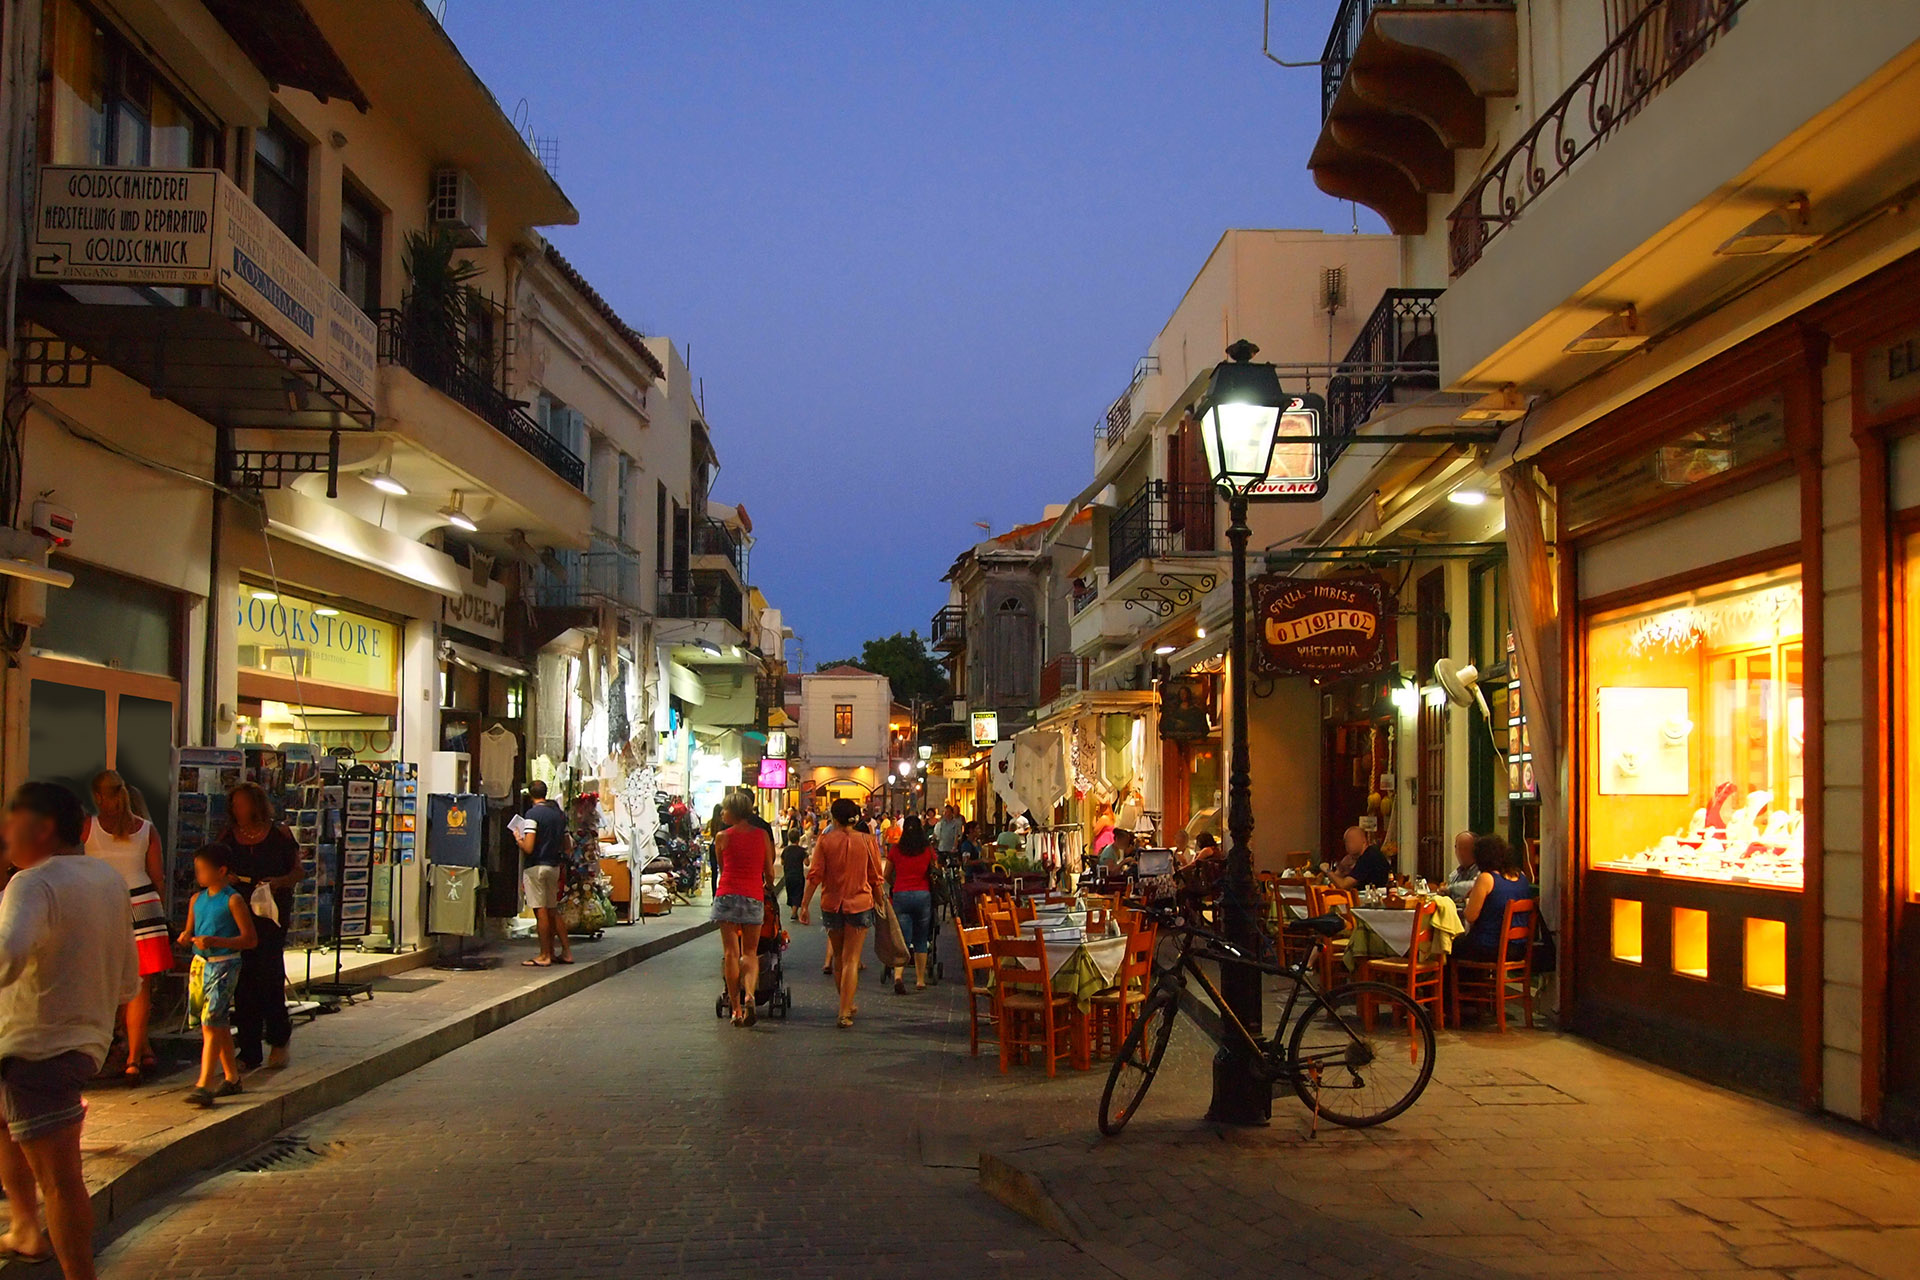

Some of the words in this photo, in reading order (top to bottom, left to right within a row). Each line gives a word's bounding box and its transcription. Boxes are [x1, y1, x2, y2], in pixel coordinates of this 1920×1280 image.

[69, 174, 188, 200] GOLDSCHMIEDEREI
[45, 206, 116, 230] HERSTELLUNG
[145, 209, 208, 233] REPARATUR
[86, 238, 188, 264] GOLDSCHMUCK
[63, 267, 118, 278] EINGANG
[183, 270, 198, 280] STR
[237, 253, 312, 335] ΚΟΣΜΗΜΑΤΑ
[450, 593, 504, 629] QUEEN
